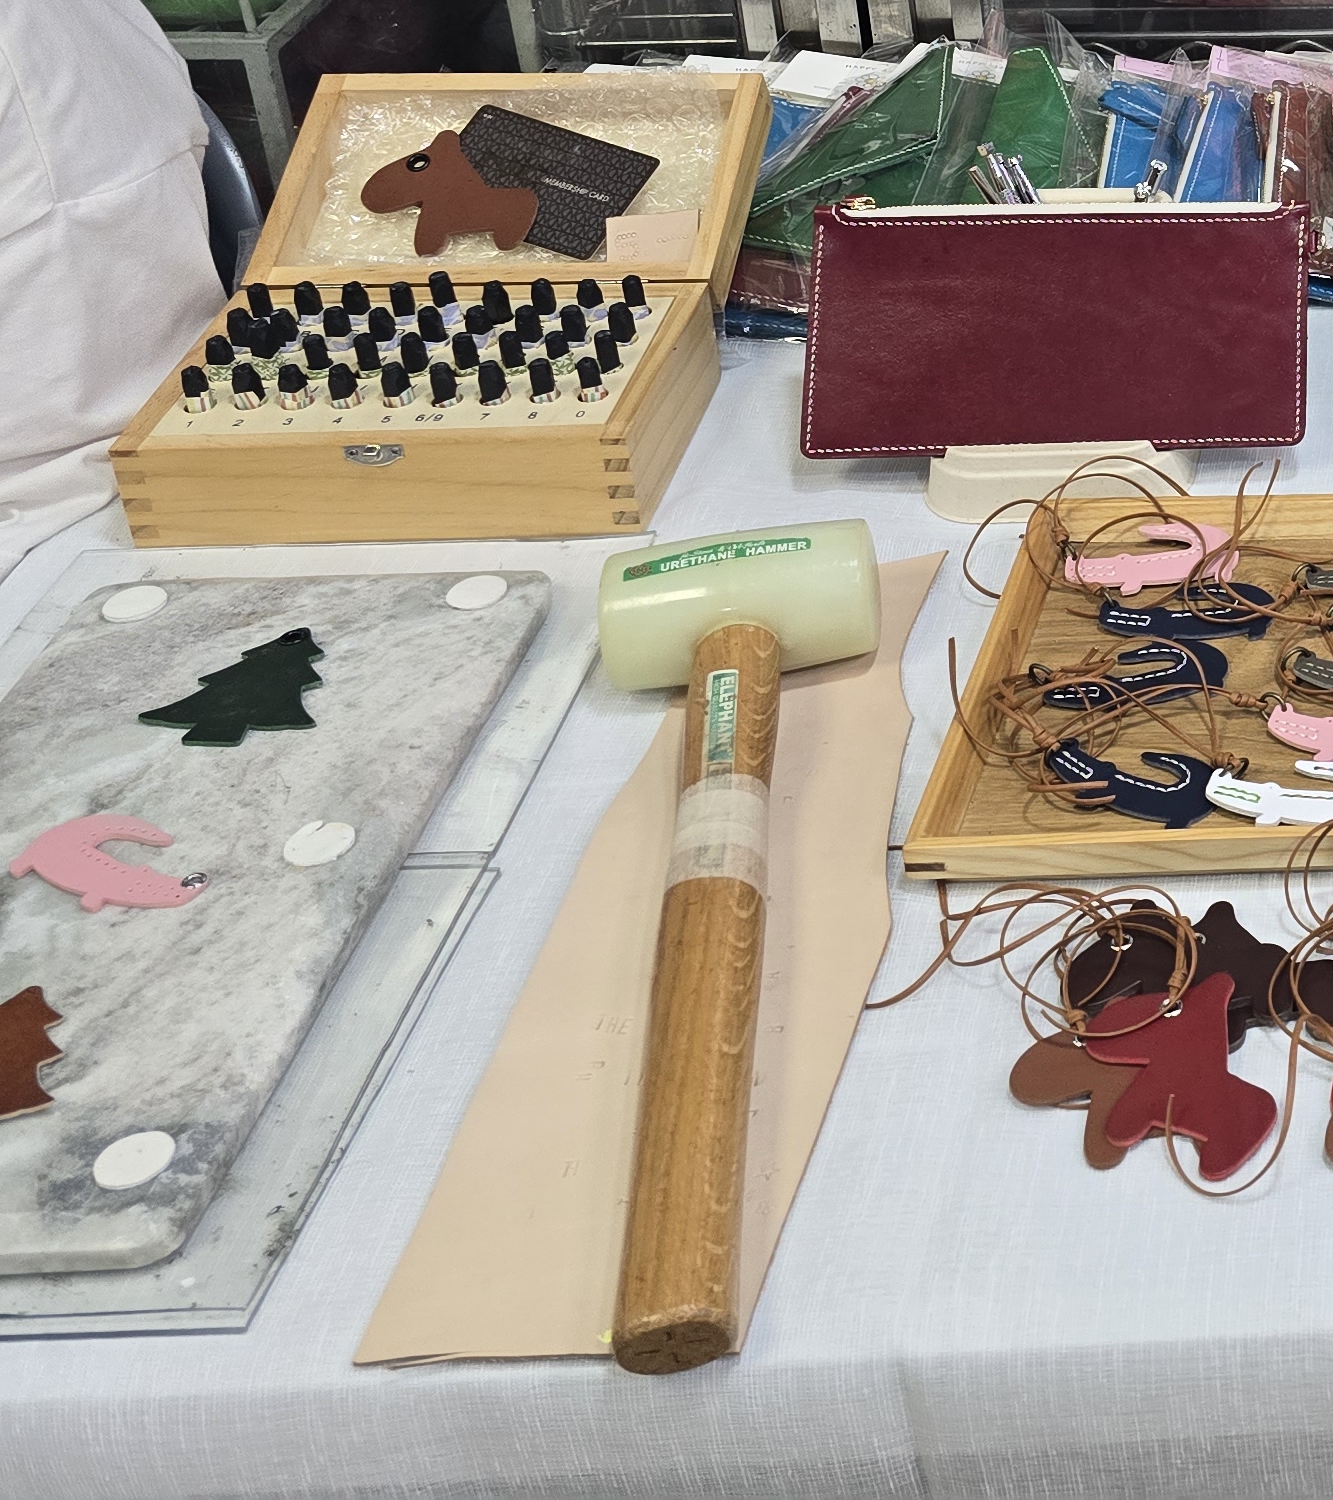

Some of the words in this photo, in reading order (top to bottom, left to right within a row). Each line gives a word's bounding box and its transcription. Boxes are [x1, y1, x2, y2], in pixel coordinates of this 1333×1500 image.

[187, 420, 193, 428] 1
[232, 419, 244, 427] 2
[282, 418, 293, 426] 3
[332, 416, 342, 424] 4
[381, 415, 391, 424] 5
[415, 413, 443, 422] 6/9
[480, 413, 491, 421] 7
[528, 411, 538, 420] 8
[576, 410, 585, 418] 0
[661, 551, 736, 572] URETHANE
[746, 541, 807, 556] HAMMER
